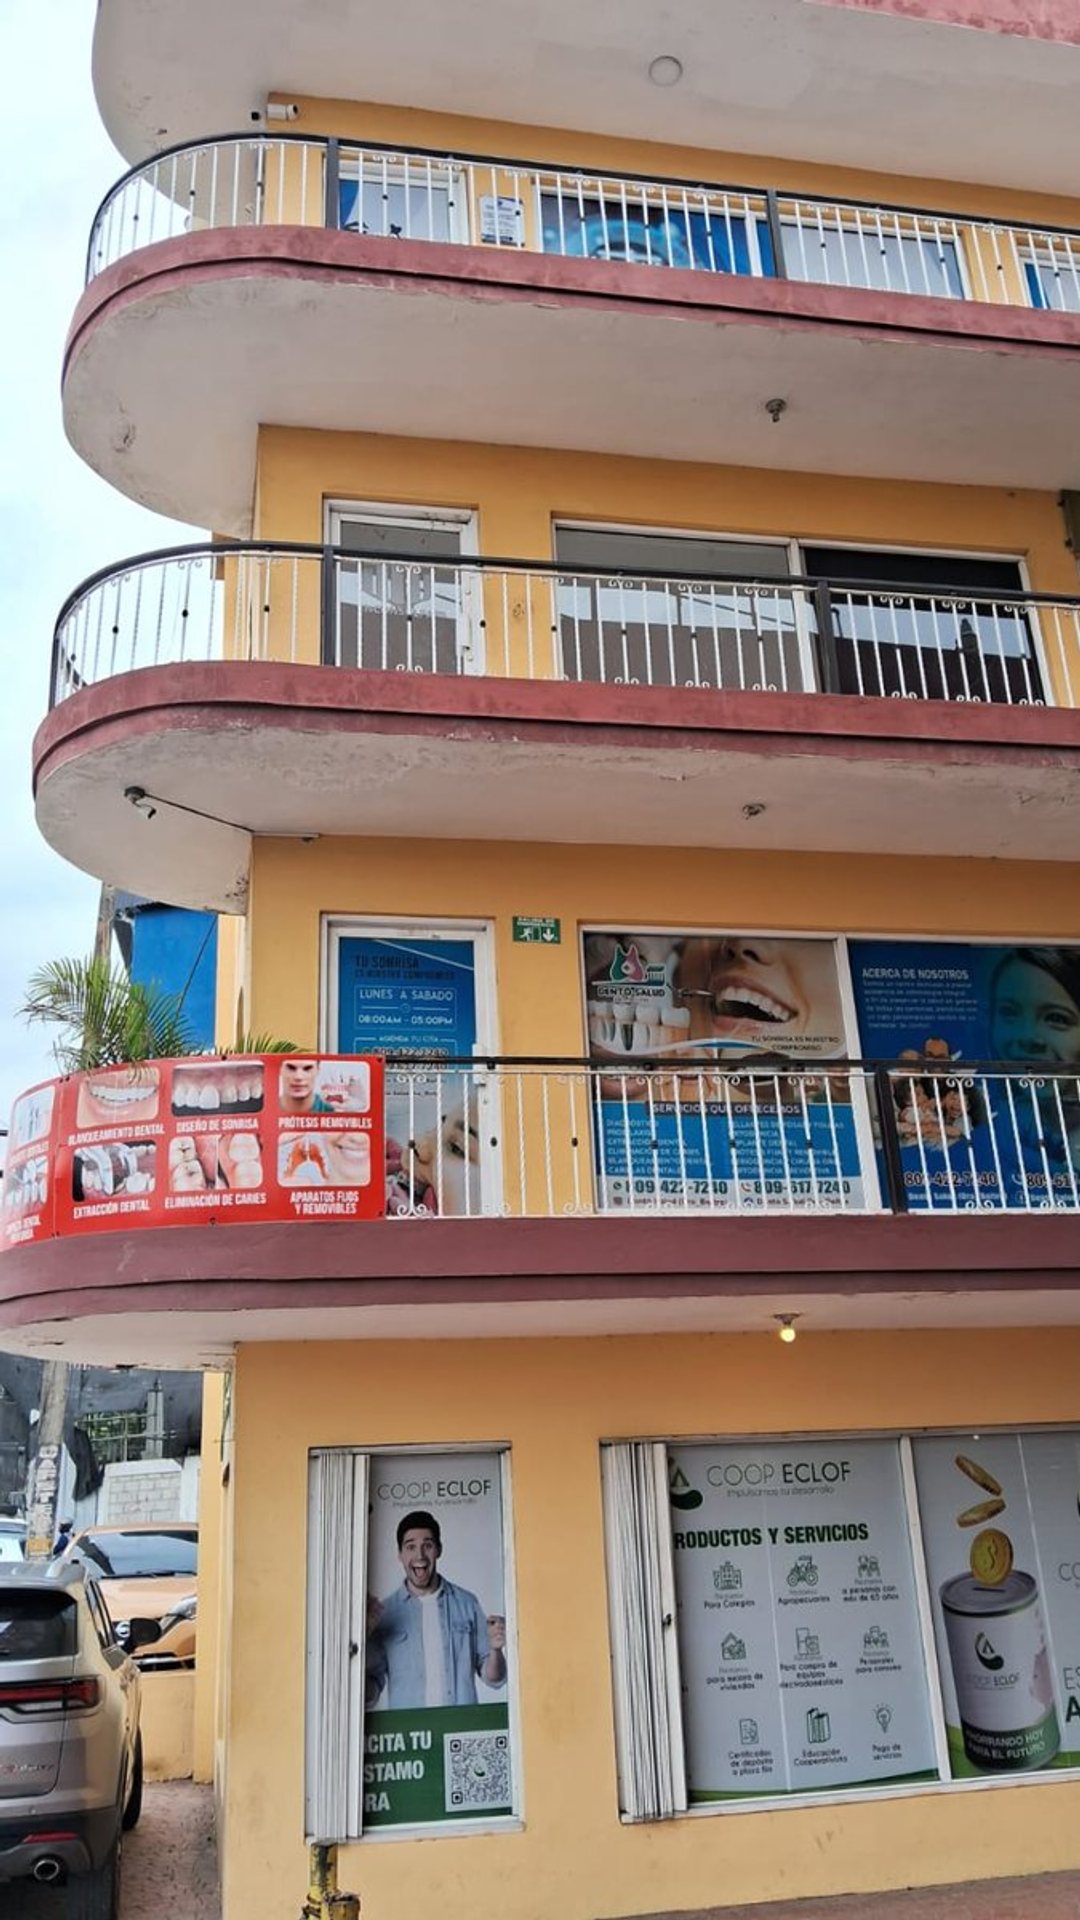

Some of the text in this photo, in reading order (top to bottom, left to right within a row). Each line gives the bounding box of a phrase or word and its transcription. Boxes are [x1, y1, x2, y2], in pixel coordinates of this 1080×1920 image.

[862, 967, 969, 980] ACERCA DE NOSOTROS
[360, 989, 393, 1000] LUNES
[400, 990, 408, 1000] A
[710, 1104, 732, 1114] QU
[134, 1123, 166, 1138] DENTAL
[209, 1119, 219, 1131] DE
[221, 1117, 259, 1130] SONRISA
[320, 1117, 372, 1129] REMOVIBLES
[165, 1191, 267, 1209] ELIMINACIÓN DE CARIES
[290, 1190, 359, 1202] APARATOS FIJOS
[74, 1199, 150, 1219] EXTRACCIÓN DENTAL
[294, 1202, 357, 1215] Y REMOVIBLES
[706, 1460, 852, 1488] COOP ECLOF
[377, 1479, 491, 1500] COOP ECLOF
[767, 1528, 778, 1545] Y
[784, 1523, 869, 1545] SERVICIOS
[364, 1730, 432, 1753] CITA TU
[1025, 1727, 1044, 1742] HOY
[991, 1748, 1005, 1759] EL
[1006, 1741, 1046, 1759] FUTURO
